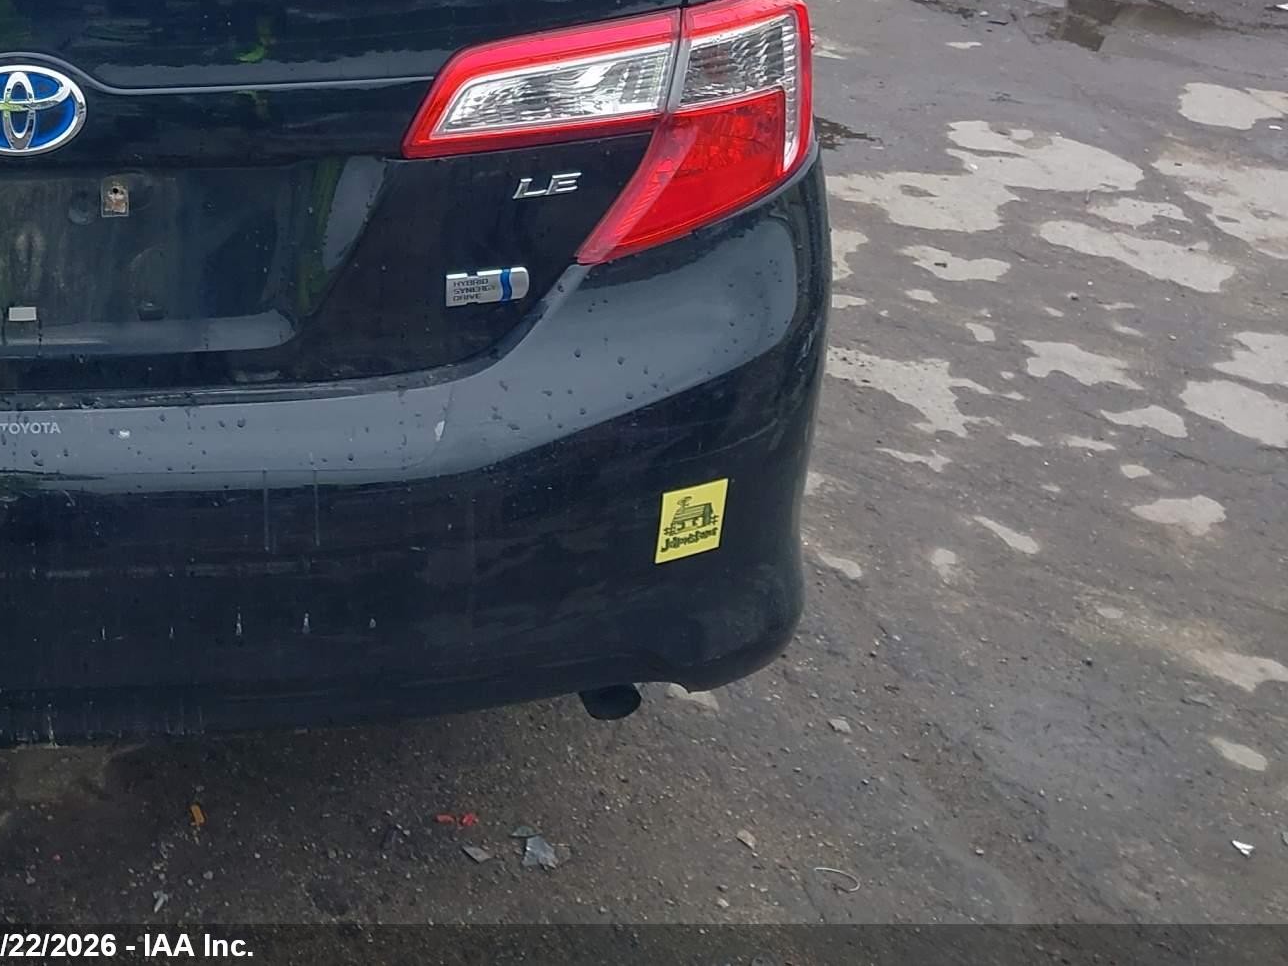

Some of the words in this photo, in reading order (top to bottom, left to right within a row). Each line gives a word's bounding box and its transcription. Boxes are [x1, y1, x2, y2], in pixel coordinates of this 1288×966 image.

[513, 172, 582, 199] LE
[453, 278, 489, 287] HYBRID
[0, 421, 61, 435] TOYOTA
